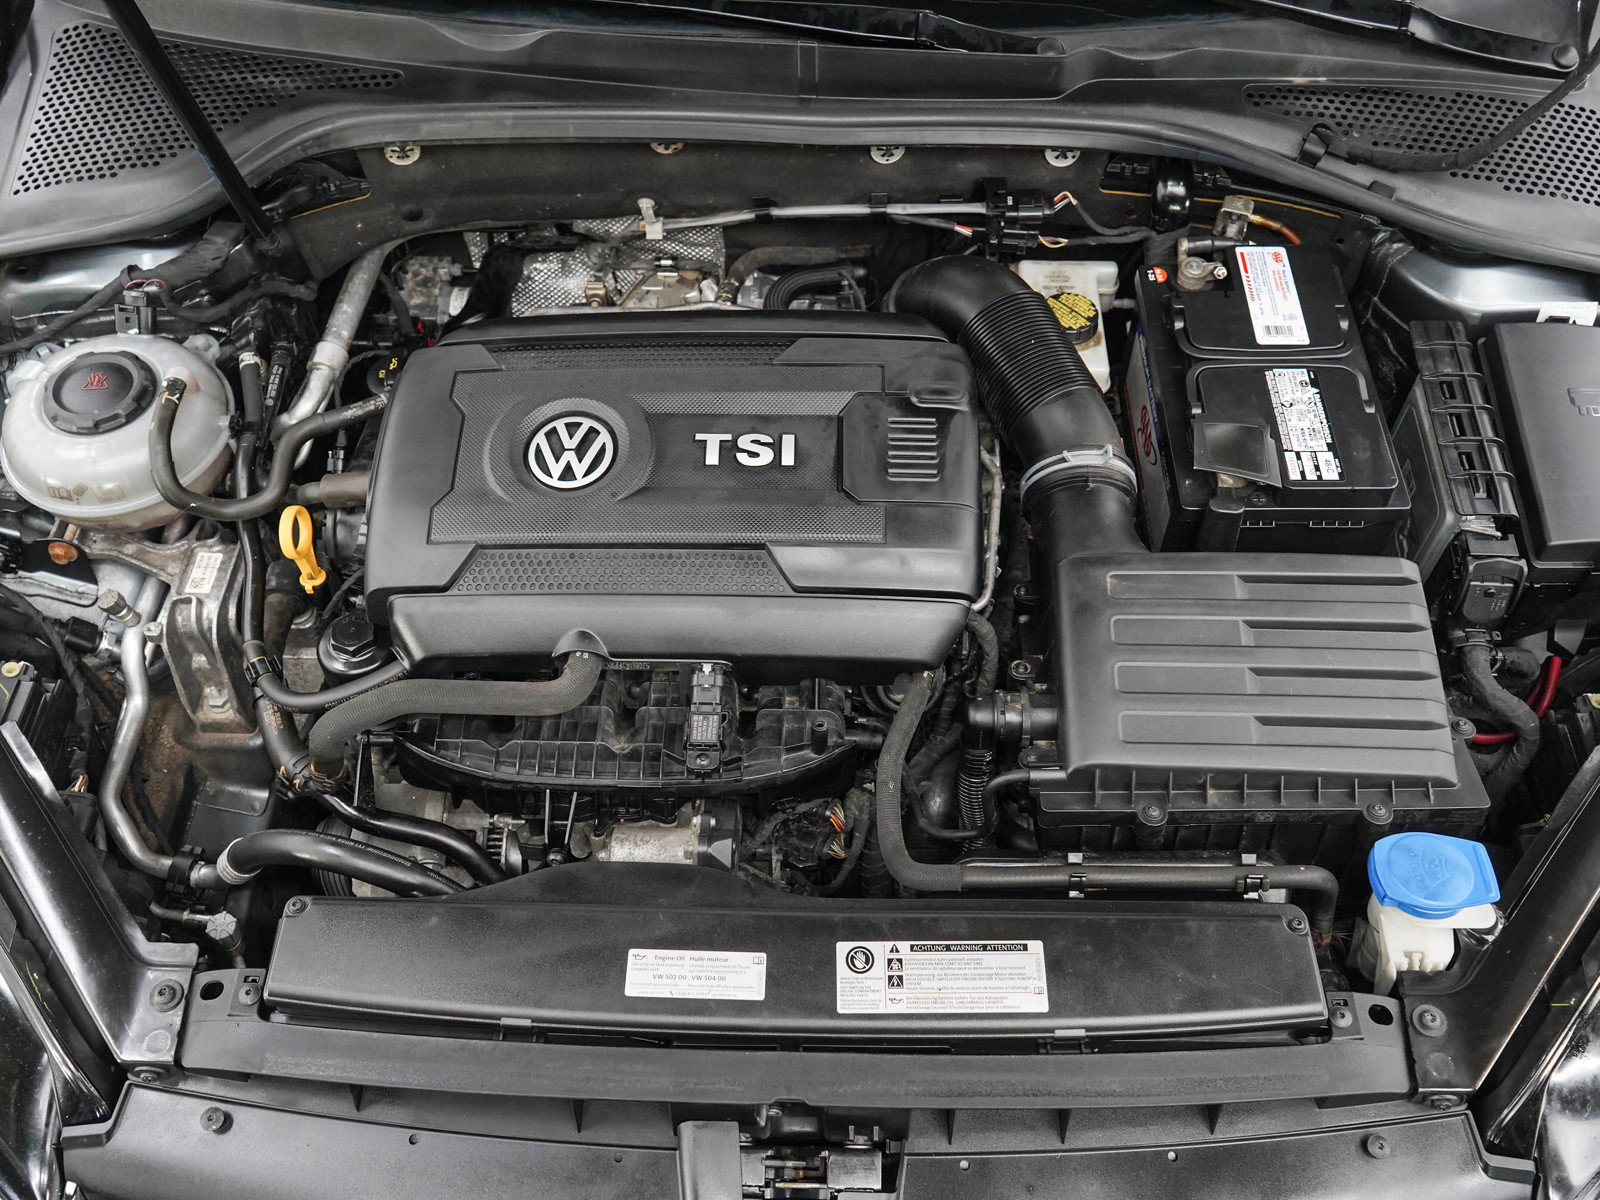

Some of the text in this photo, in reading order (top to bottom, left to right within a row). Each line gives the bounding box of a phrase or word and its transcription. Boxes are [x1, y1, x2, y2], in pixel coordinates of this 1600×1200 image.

[694, 433, 796, 467] TSI
[913, 944, 947, 952] ACHTUNG
[950, 944, 983, 952] WARNING
[654, 954, 675, 962] Engine
